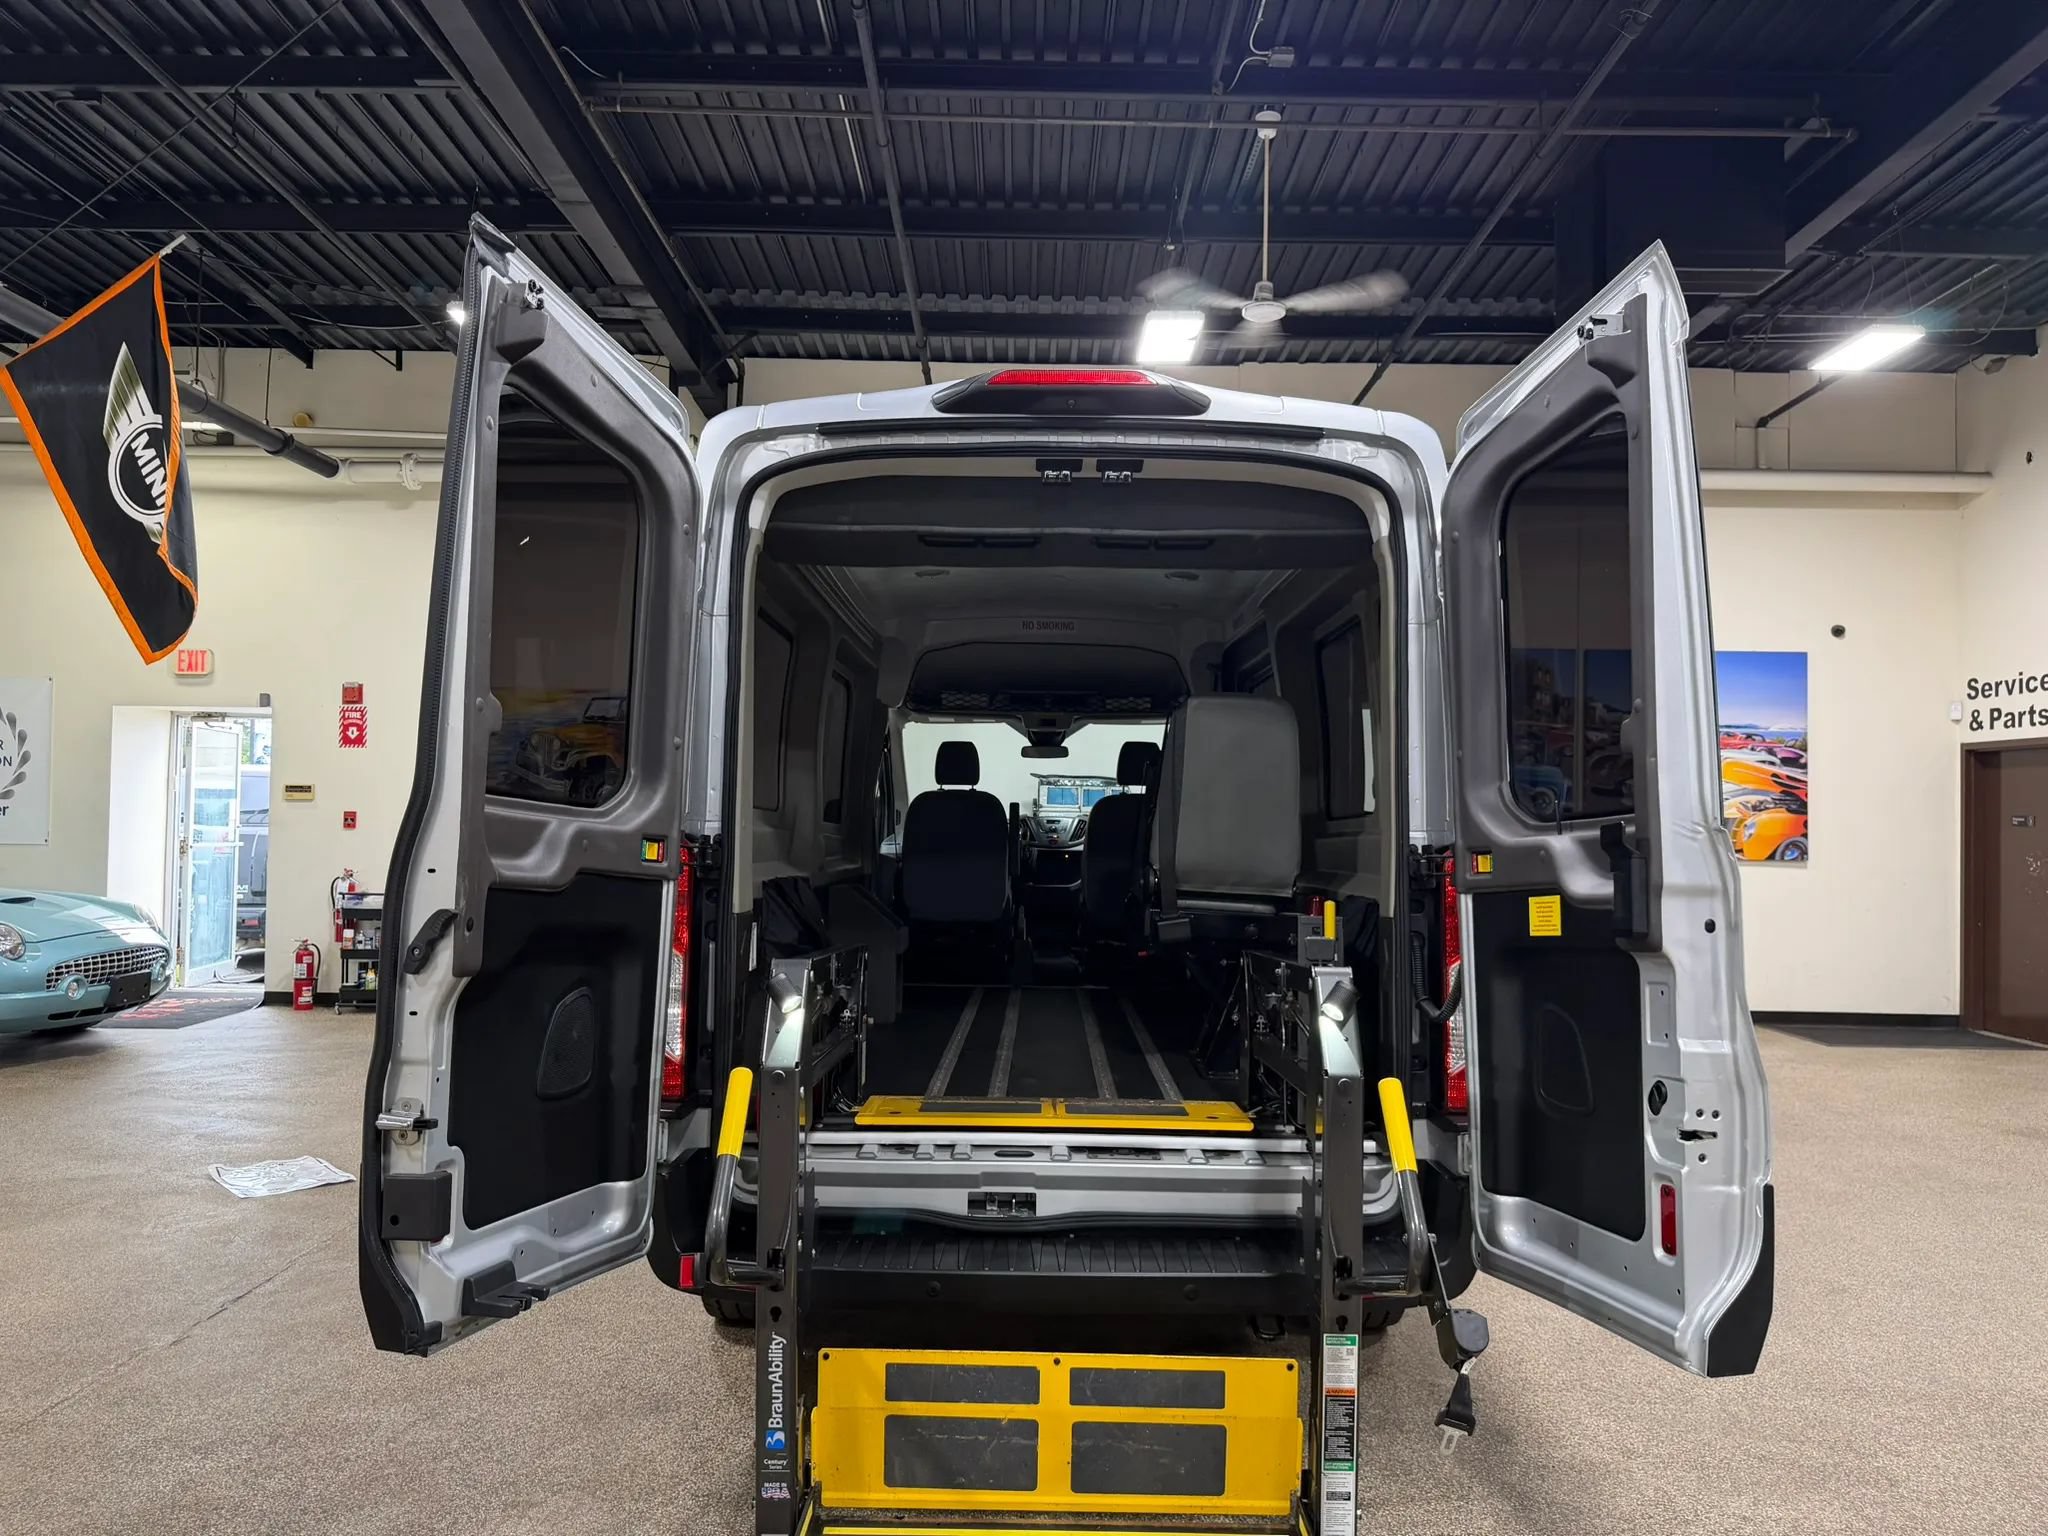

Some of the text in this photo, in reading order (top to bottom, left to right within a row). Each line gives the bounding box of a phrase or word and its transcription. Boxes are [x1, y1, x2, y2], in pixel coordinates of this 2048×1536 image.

[1036, 621, 1075, 632] SMOKING
[178, 649, 207, 672] EXIT
[1967, 671, 2048, 700] Service
[1969, 704, 2048, 732] & Parts
[768, 1334, 787, 1429] BraunAbility
[761, 1487, 791, 1499] USA
